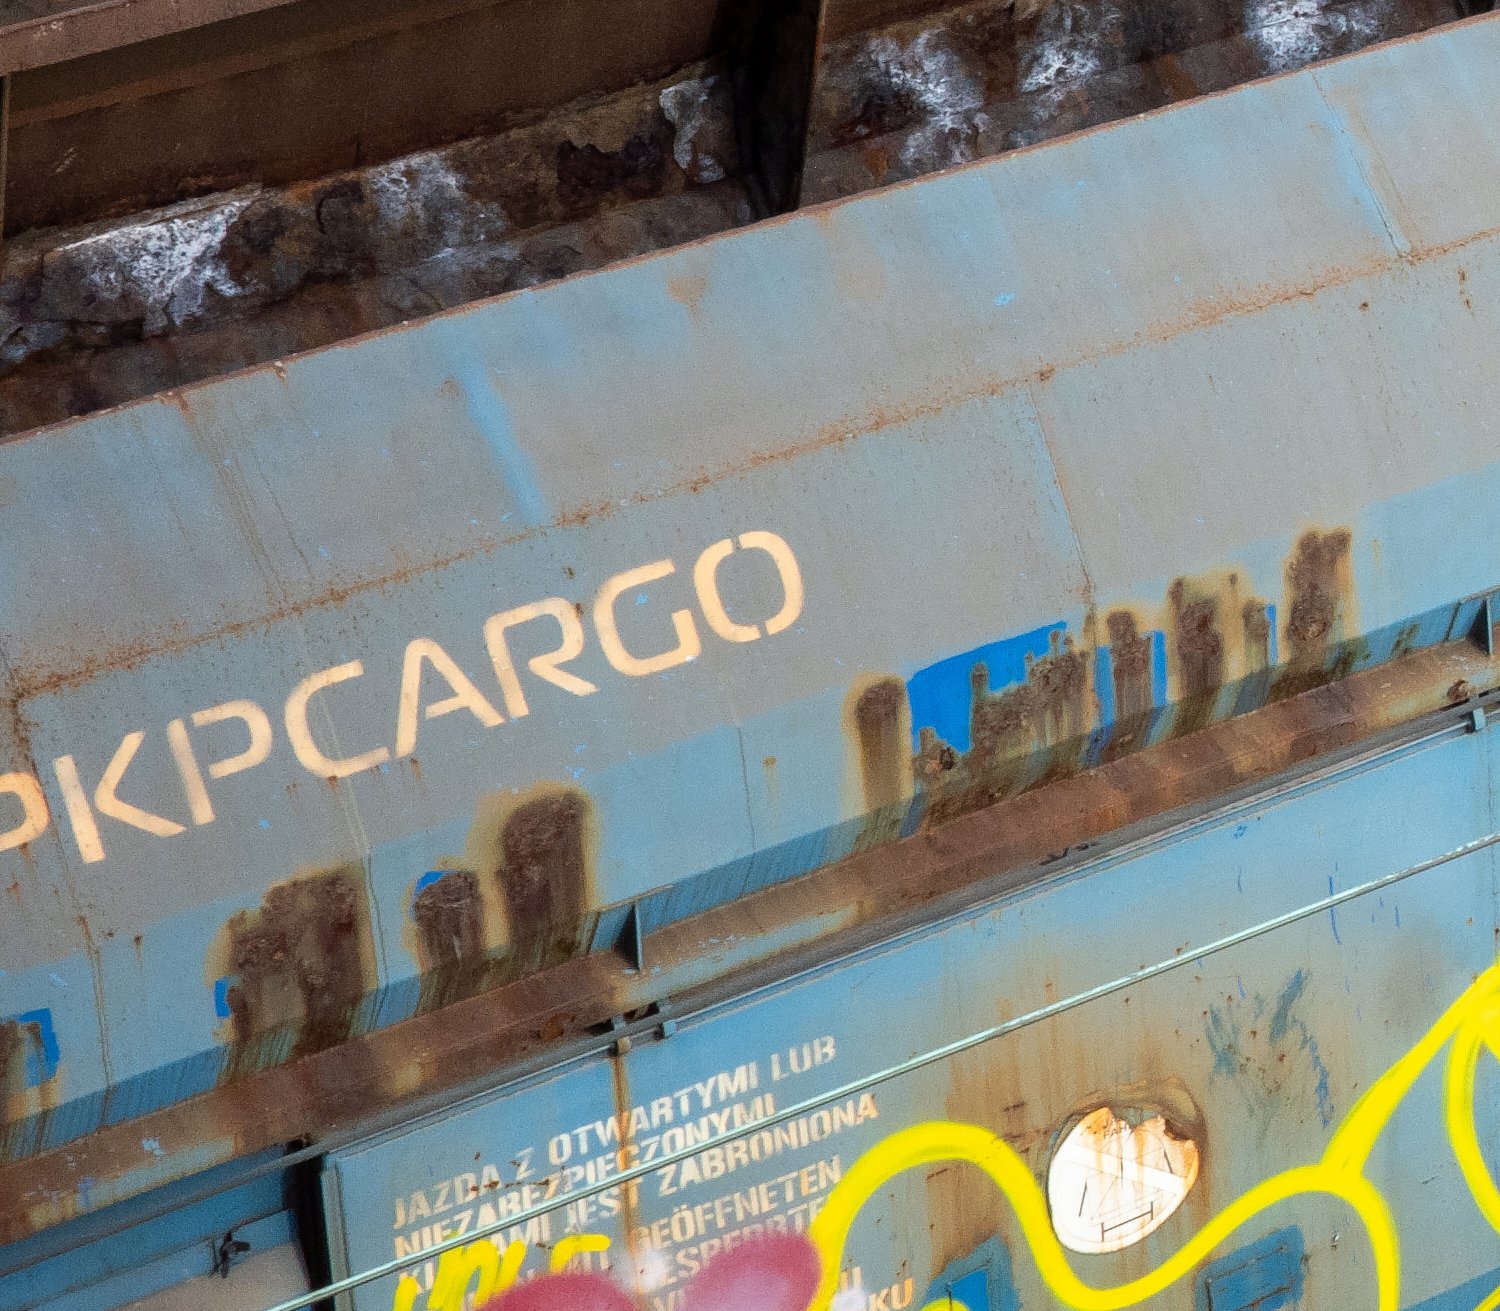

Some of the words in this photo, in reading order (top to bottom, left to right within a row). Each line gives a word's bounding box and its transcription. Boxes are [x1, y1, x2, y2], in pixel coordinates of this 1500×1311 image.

[393, 1163, 501, 1230] JAZDA
[515, 1146, 538, 1181] Z
[547, 1060, 760, 1167] OTWARTYMI
[770, 1034, 838, 1083] LUB
[657, 1091, 880, 1198] ZABRONIONA
